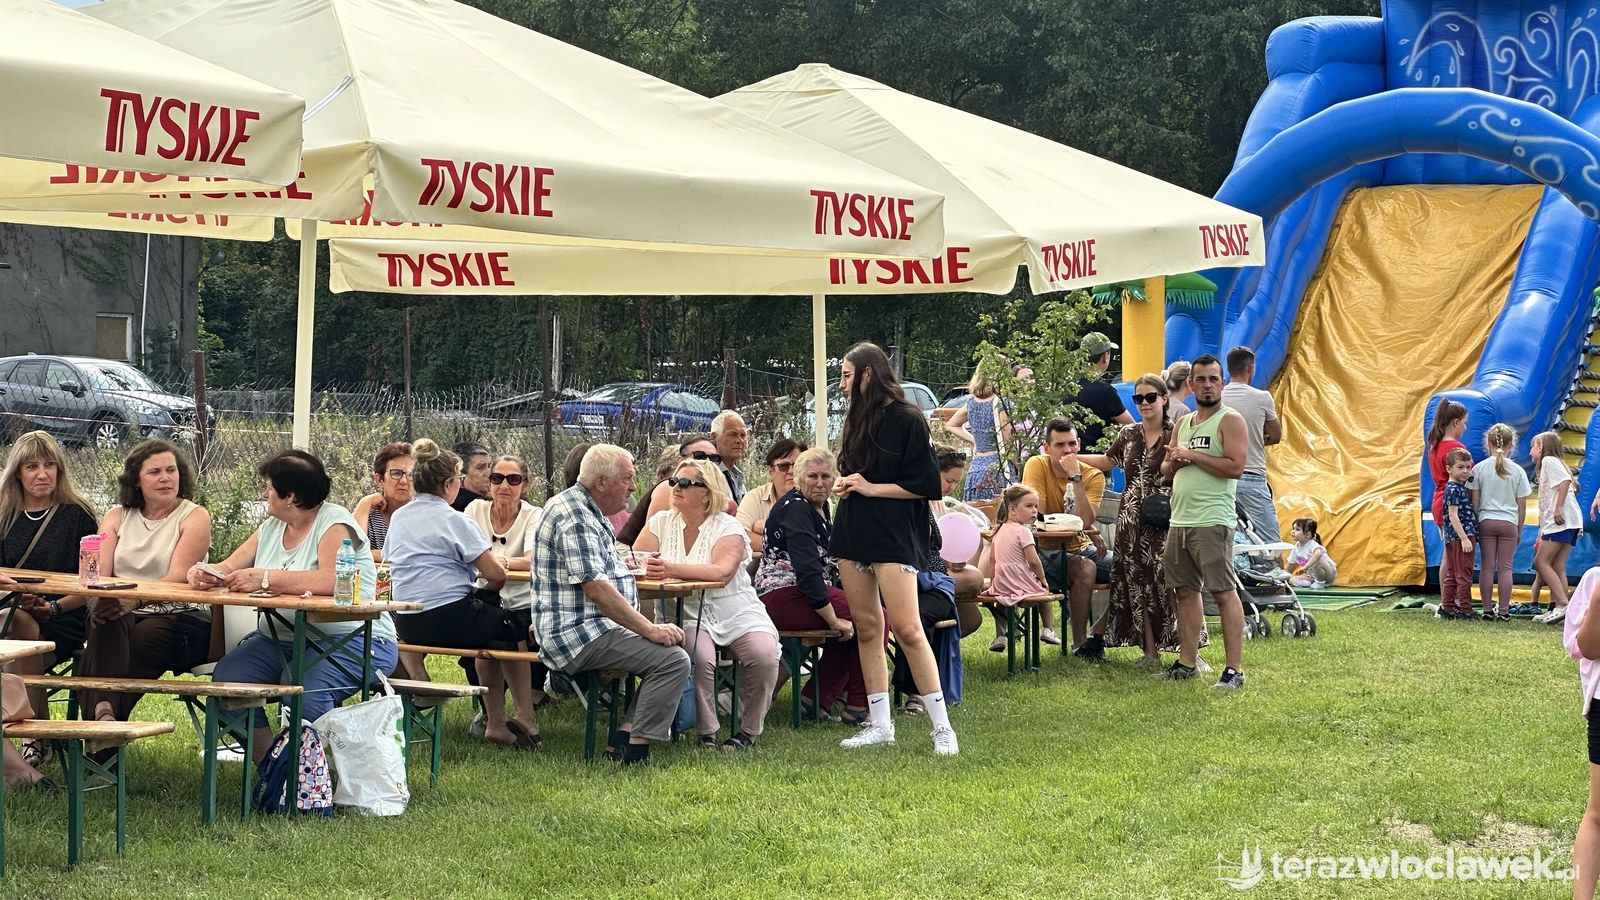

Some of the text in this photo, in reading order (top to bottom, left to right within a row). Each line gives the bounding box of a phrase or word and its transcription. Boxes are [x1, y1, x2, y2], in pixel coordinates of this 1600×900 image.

[100, 88, 260, 166] TYSKIE
[418, 158, 555, 218] TYSKIE
[810, 190, 915, 241] TYSKIE
[1041, 239, 1097, 282] TYSKIE
[1199, 224, 1250, 258] TYSKIE
[377, 252, 515, 287] TYSKIE
